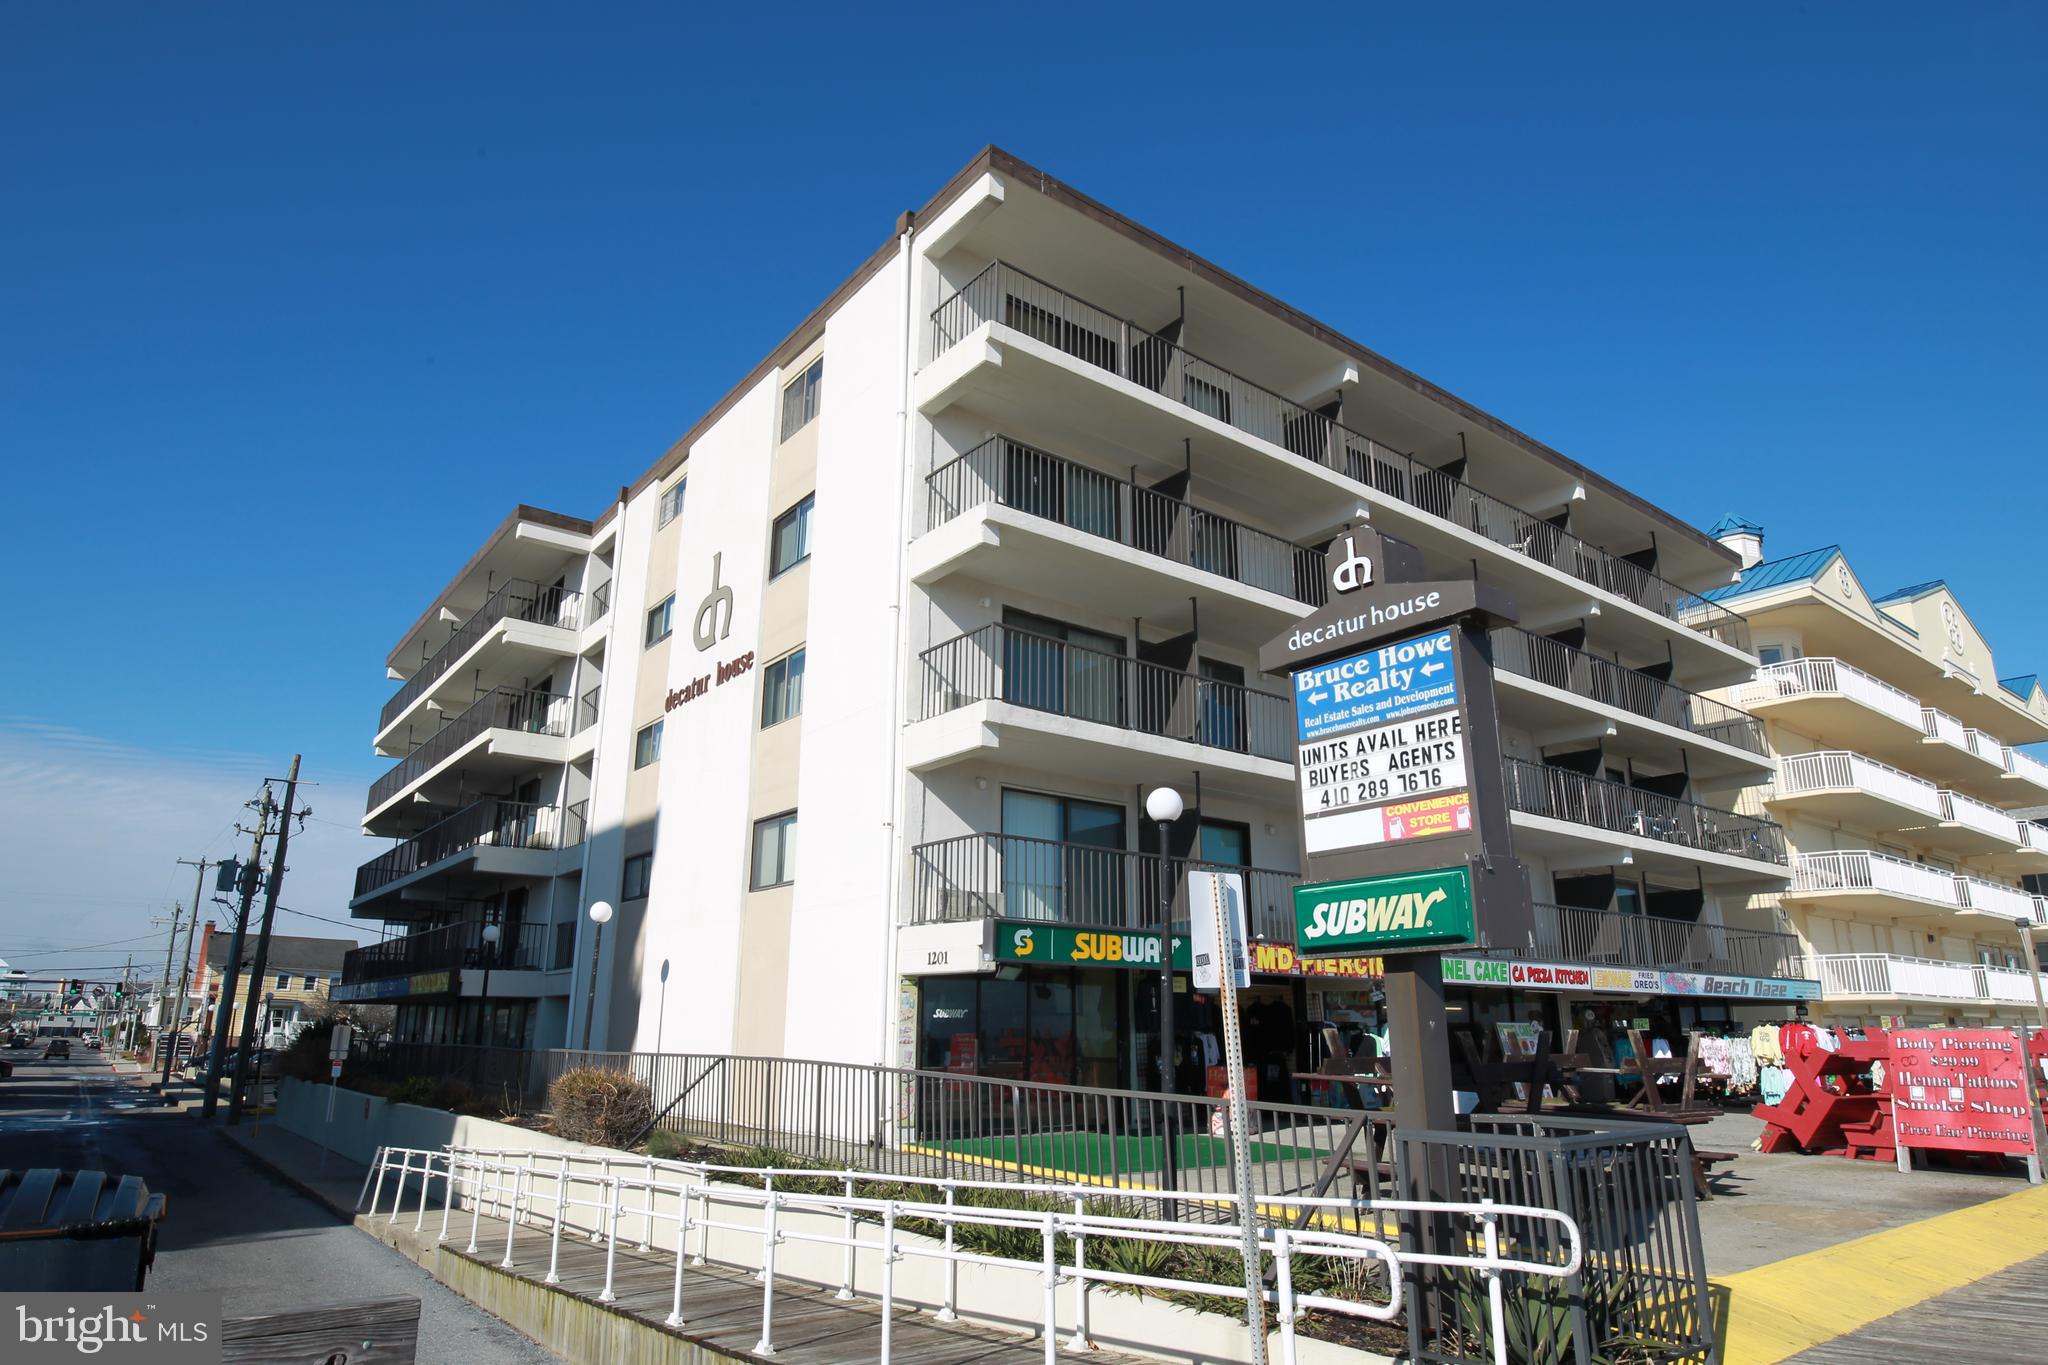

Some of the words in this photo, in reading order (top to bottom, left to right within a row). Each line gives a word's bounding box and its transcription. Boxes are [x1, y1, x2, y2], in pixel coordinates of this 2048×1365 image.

[1288, 613, 1366, 651] decatur
[1371, 591, 1440, 626] house
[1298, 658, 1370, 692] Bruce
[1378, 634, 1452, 669] Howe
[664, 672, 711, 713] decatur
[716, 650, 755, 687] house
[1334, 667, 1415, 703] Realty
[1304, 716, 1322, 728] Real
[1324, 710, 1350, 724] Estate
[1351, 703, 1374, 717] Sales
[1376, 697, 1393, 711] and
[1394, 682, 1454, 705] Development
[1302, 741, 1348, 766] UNITS
[1356, 728, 1408, 756] AVAIL
[1415, 716, 1462, 743] HERE
[1309, 759, 1370, 787] BUYERS
[1388, 741, 1456, 771] AGENTS
[1321, 786, 1349, 807] 410
[1357, 778, 1389, 800] 289
[1397, 768, 1442, 792] 7676
[1386, 793, 1469, 817] CONVENIENCE
[1409, 812, 1451, 828] STORE
[1304, 887, 1447, 940] SUBWAY
[927, 951, 949, 965] 1201
[1257, 946, 1294, 970] MD
[1474, 961, 1508, 982] CAKE
[1512, 965, 1525, 983] CA
[1527, 966, 1553, 984] PIZZA
[1555, 967, 1590, 985] KITCHEN
[1638, 971, 1655, 980] FRIED
[1634, 980, 1660, 990] OREO'S
[1703, 977, 1749, 995] Beach
[1753, 980, 1788, 997] Daze
[933, 1008, 968, 1019] SUBWAY
[1896, 1037, 1937, 1052] Body
[1941, 1037, 2014, 1053] Piercing
[1930, 1055, 1980, 1068] $29.99
[1898, 1071, 1951, 1087] Henna
[1954, 1072, 2019, 1089] Tattoos
[1897, 1099, 1965, 1113] Smoke
[1971, 1101, 2027, 1119] Shop
[1900, 1122, 1932, 1136] Free
[1935, 1124, 1963, 1138] Ear
[1967, 1126, 2032, 1145] Piercing
